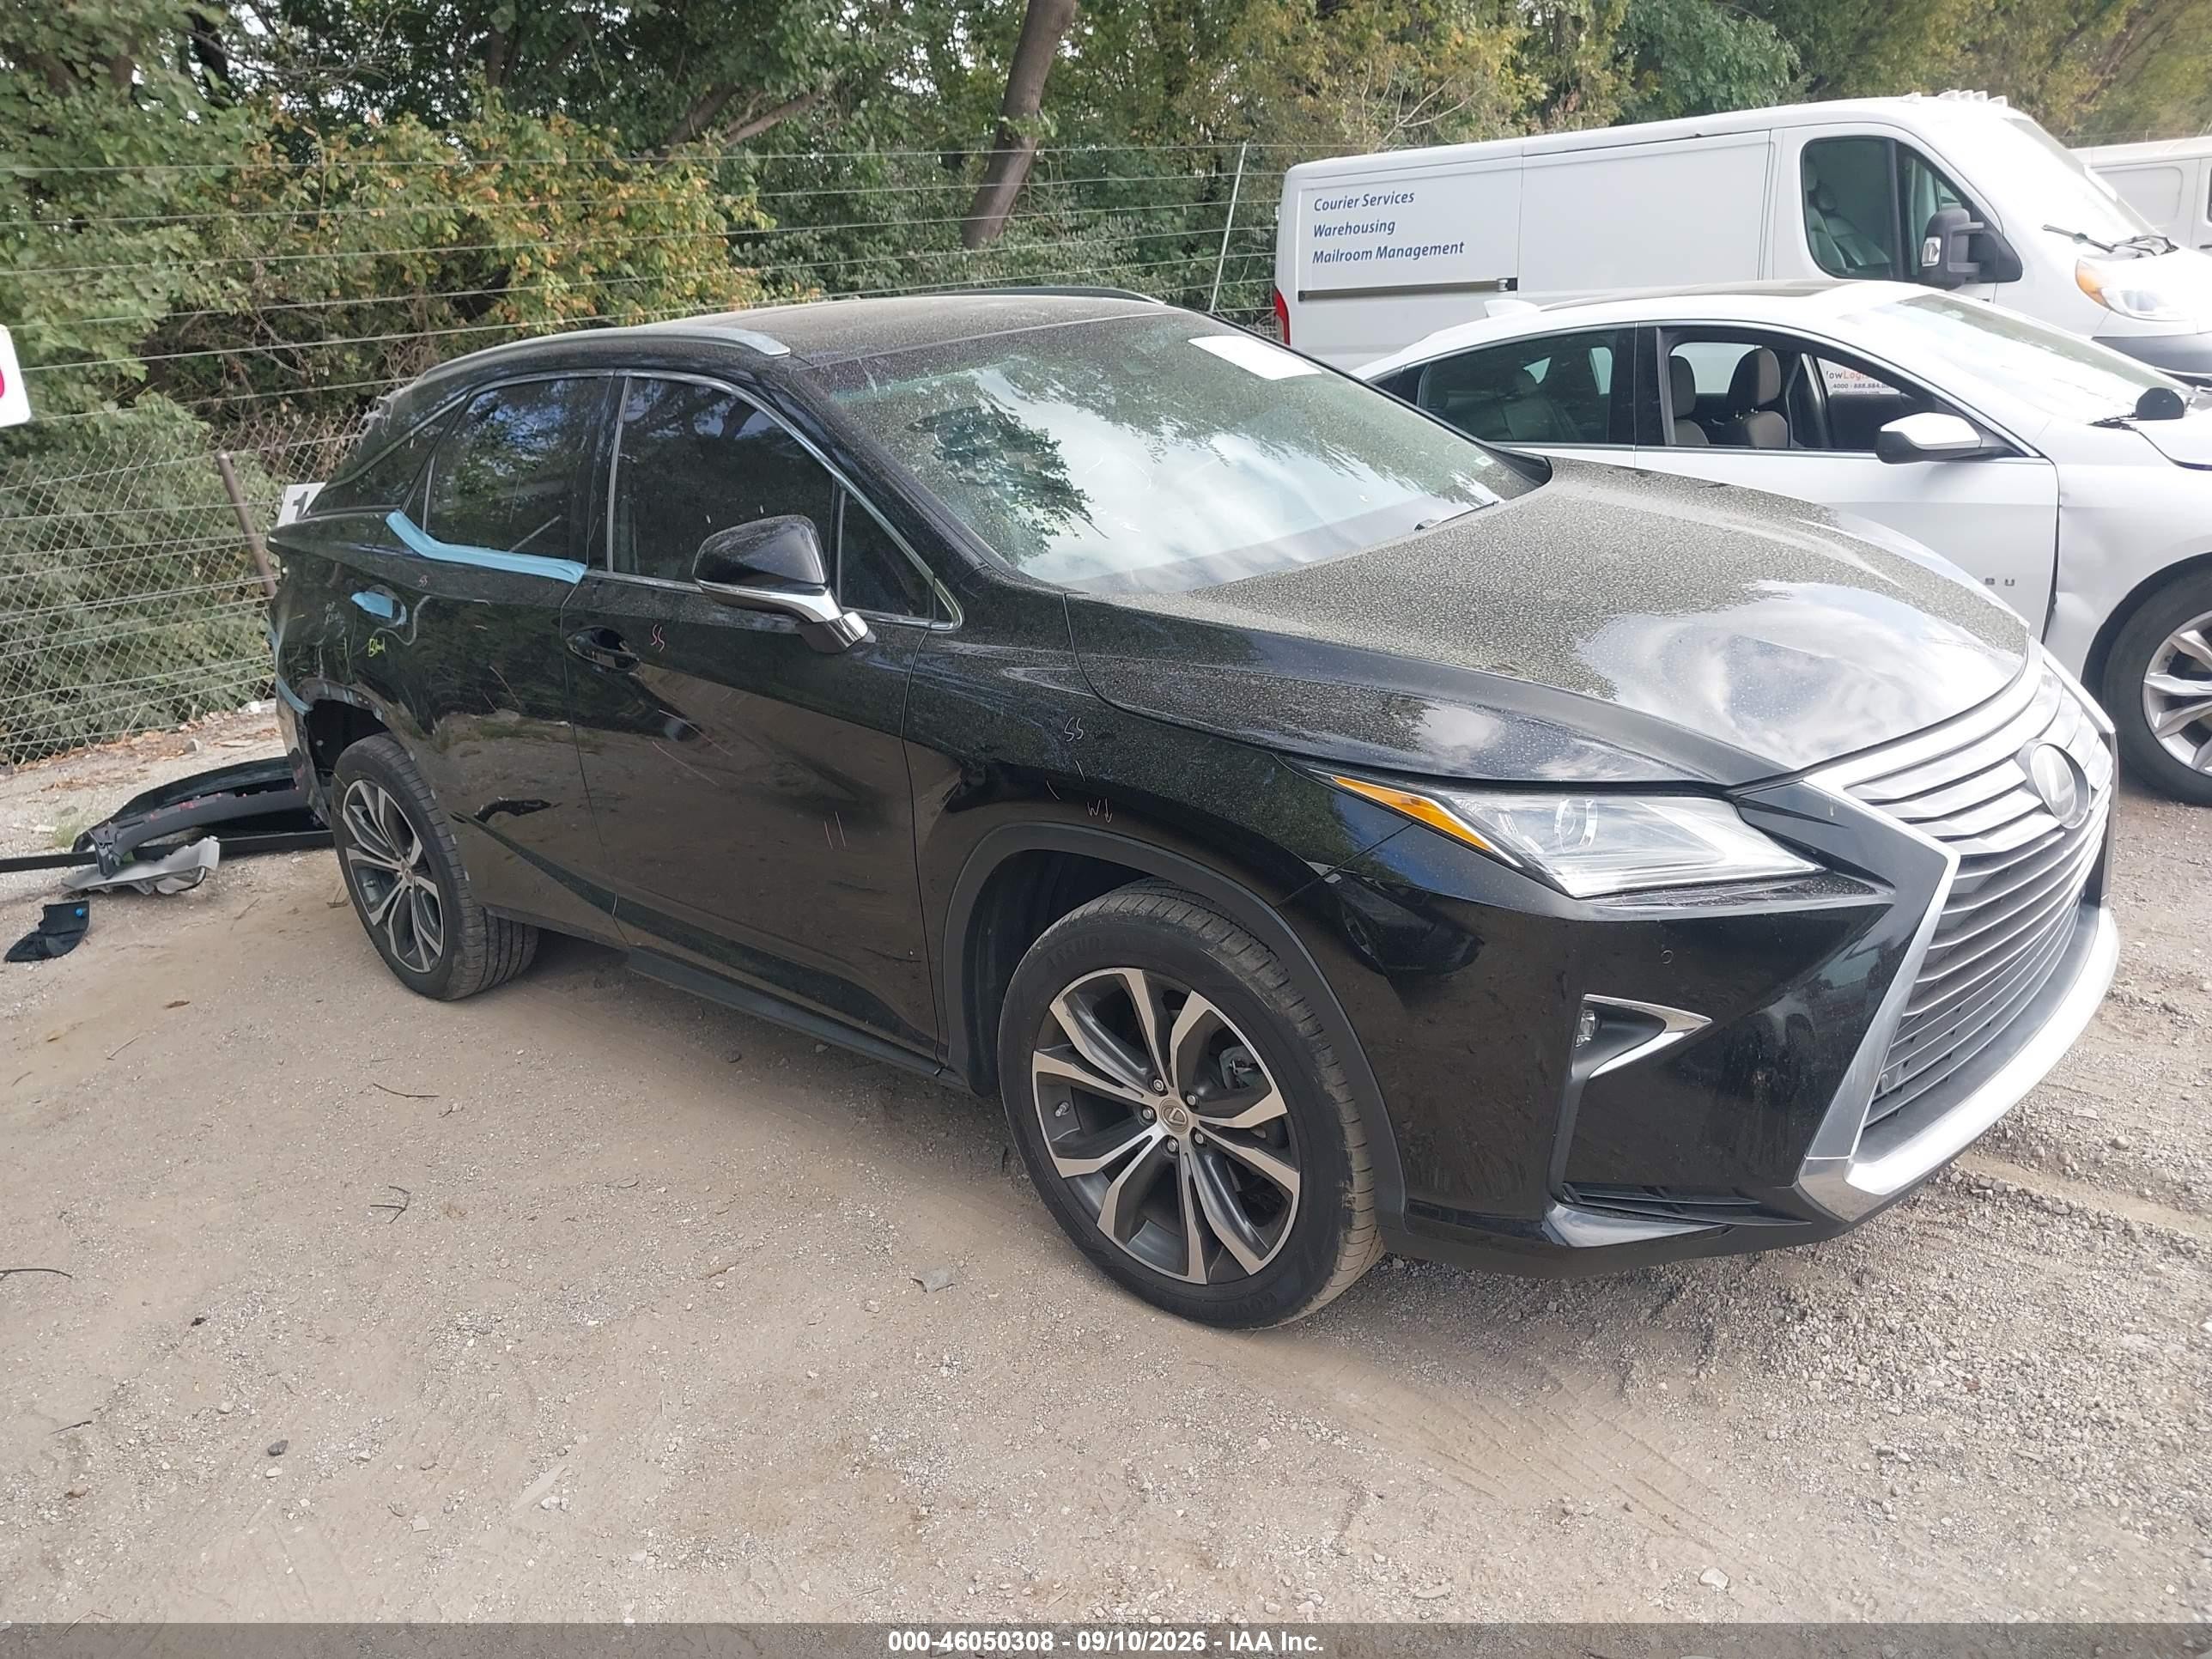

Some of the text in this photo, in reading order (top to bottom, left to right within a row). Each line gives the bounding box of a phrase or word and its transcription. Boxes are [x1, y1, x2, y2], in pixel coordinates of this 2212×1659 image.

[1314, 191, 1415, 212] Courier Services
[1313, 219, 1395, 239] Warehousing
[1312, 240, 1465, 264] Mailroom Management
